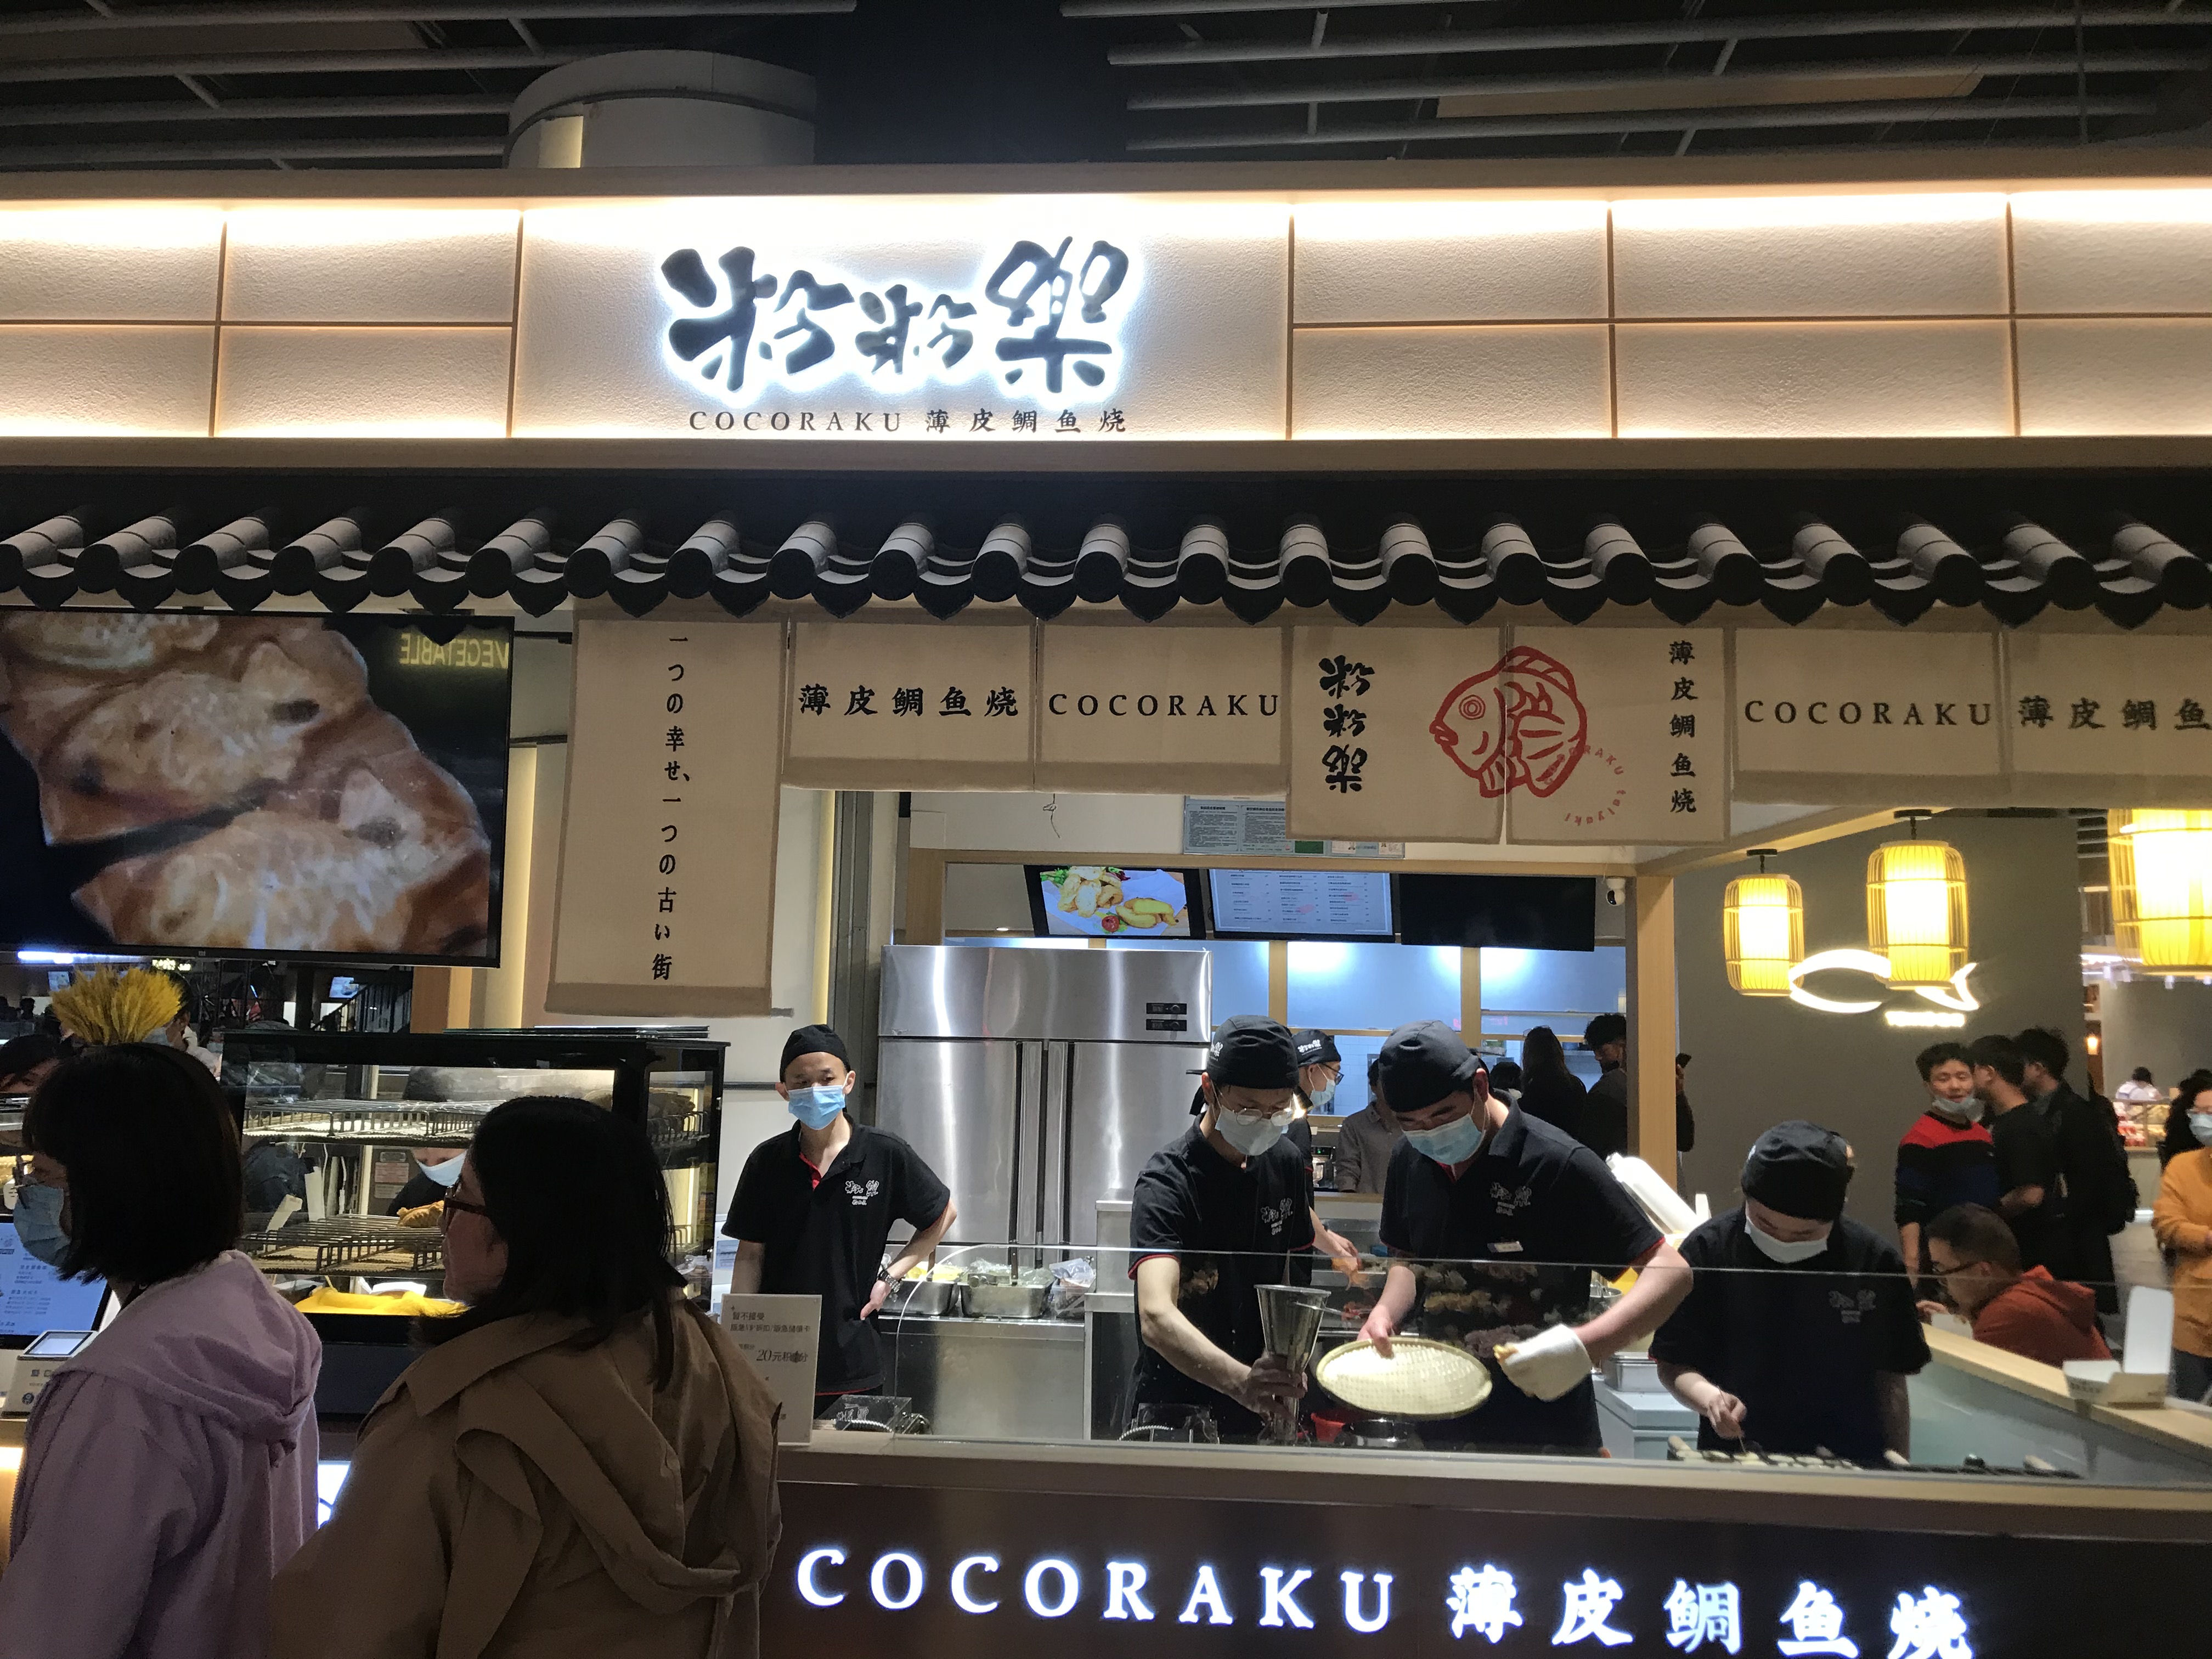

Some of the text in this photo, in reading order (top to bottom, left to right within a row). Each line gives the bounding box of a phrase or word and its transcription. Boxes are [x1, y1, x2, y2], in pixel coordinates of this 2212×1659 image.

[689, 408, 1126, 434] COCORAKU 薄皮鲷鱼烧
[798, 684, 1019, 718] 薄皮鲷鱼烧
[1048, 693, 1279, 717] COCORAKU
[1744, 700, 1991, 726] COCORAKU
[2018, 696, 2212, 731] 薄皮鲷鱼
[1669, 640, 1699, 814] 薄皮鲷鱼烧
[652, 636, 691, 980] 一つの幸せ、一つの古い街
[797, 1548, 1974, 1659] COCORAKU 薄皮鲷鱼烧
